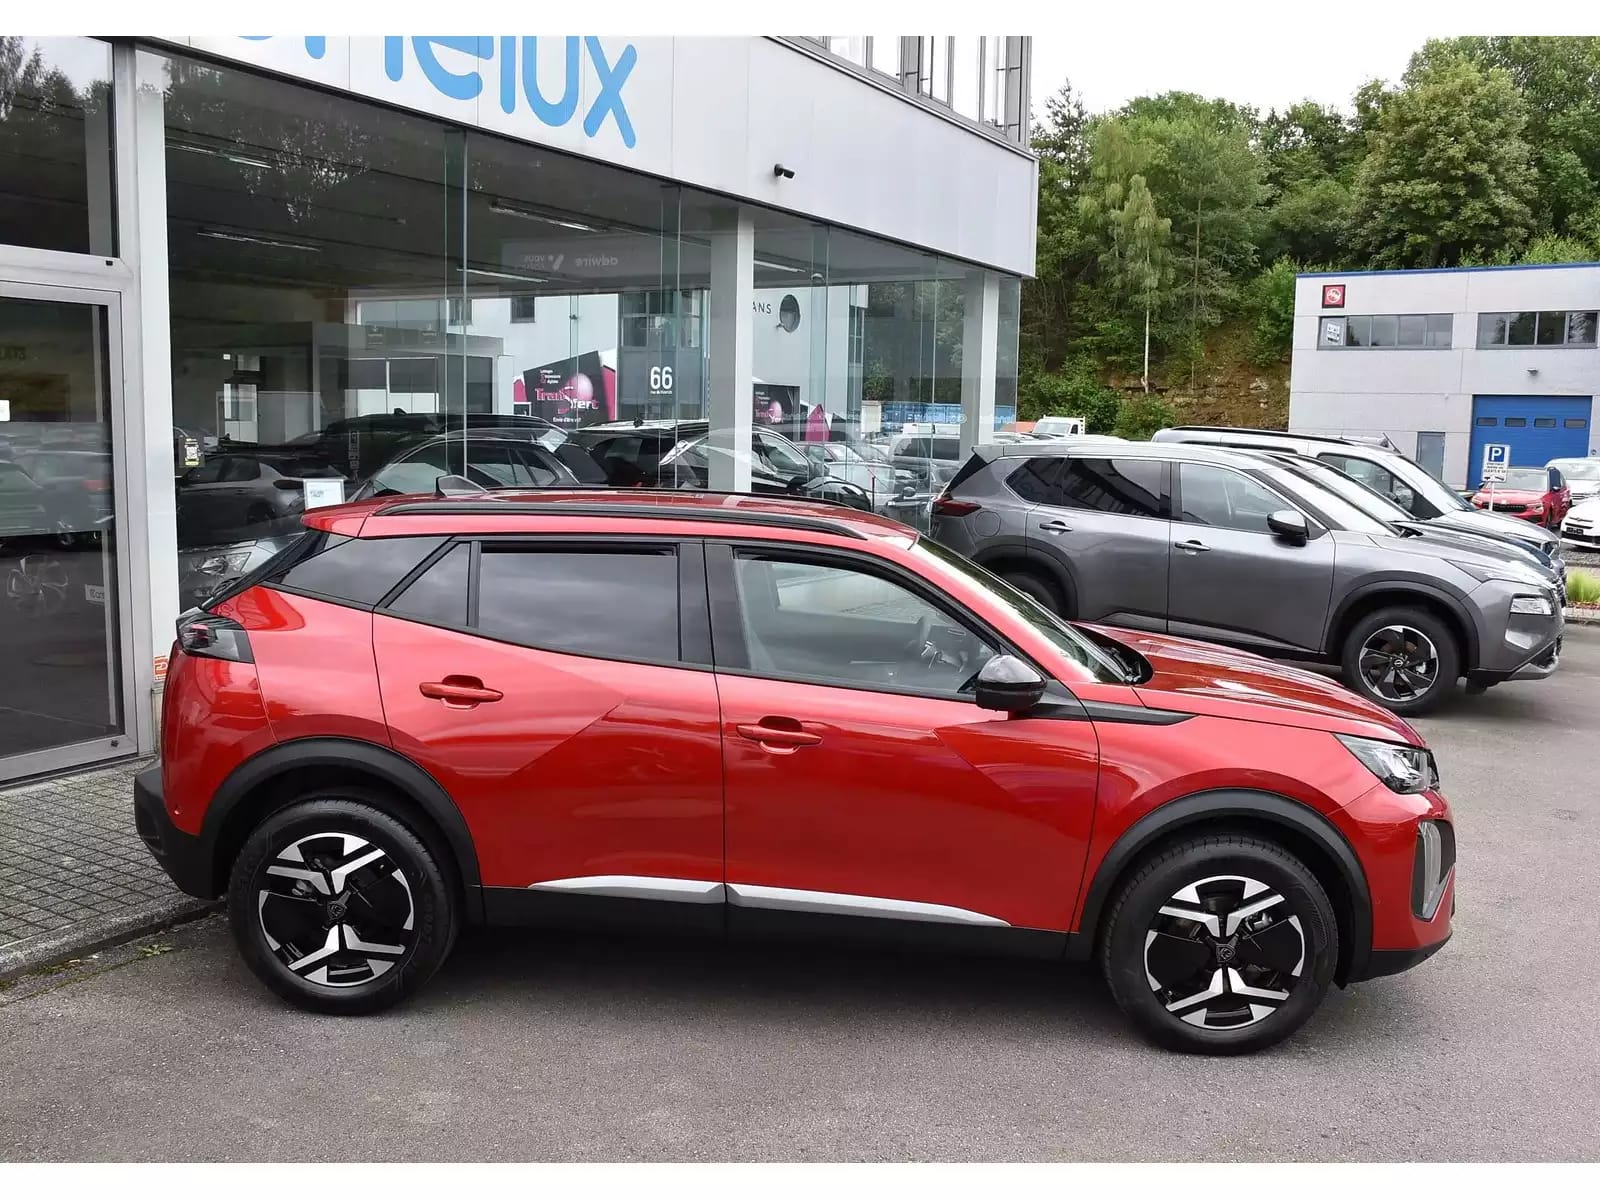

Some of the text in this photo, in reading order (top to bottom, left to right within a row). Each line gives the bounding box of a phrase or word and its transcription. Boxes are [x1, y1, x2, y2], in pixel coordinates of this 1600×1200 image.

[237, 36, 637, 149] elux
[650, 366, 673, 390] 66
[1491, 447, 1503, 461] P
